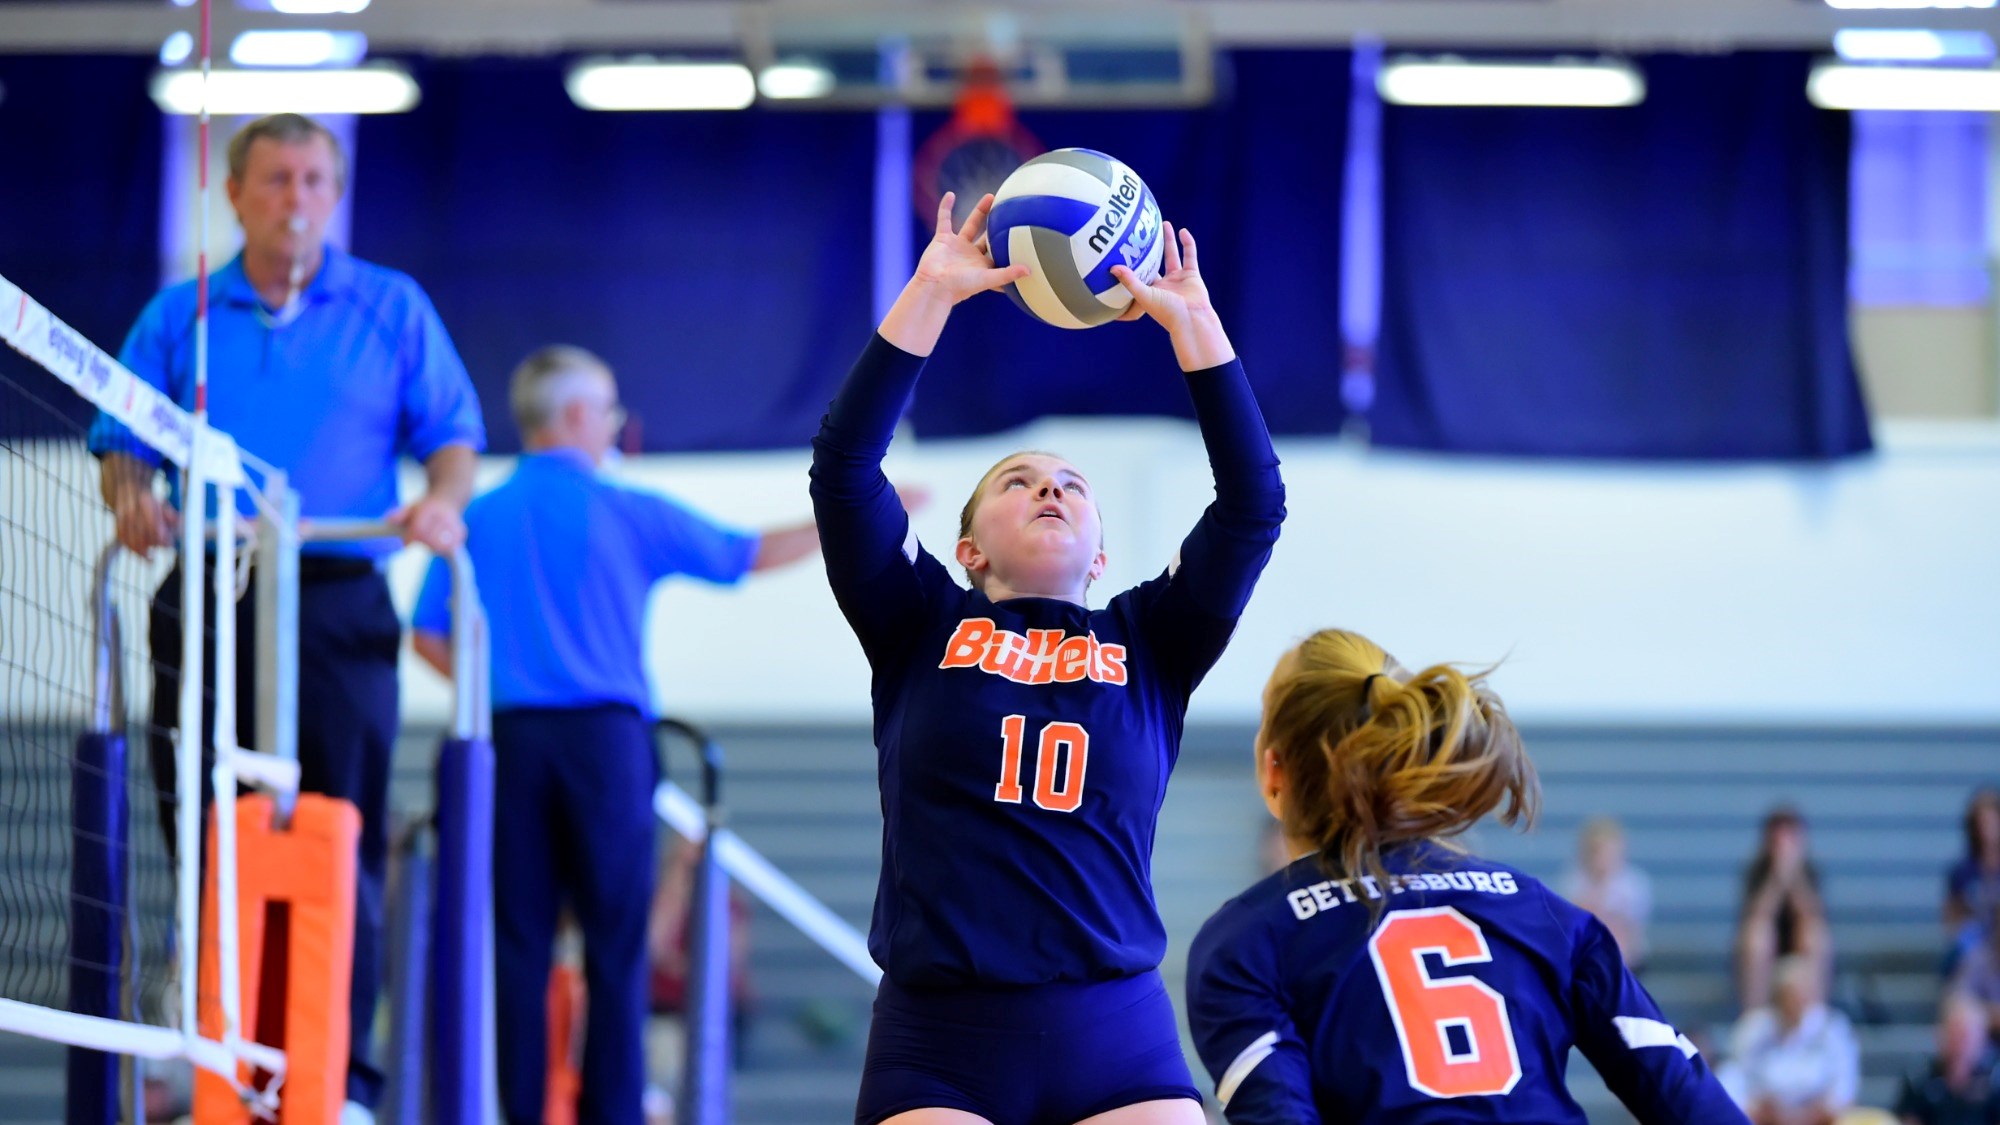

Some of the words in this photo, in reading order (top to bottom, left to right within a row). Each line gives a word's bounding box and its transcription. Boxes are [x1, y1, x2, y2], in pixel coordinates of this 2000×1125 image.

[1089, 174, 1138, 254] molten
[1118, 192, 1158, 269] NCAA
[938, 617, 1128, 686] Bullets
[994, 714, 1090, 813] 10
[1368, 905, 1523, 1099] 6
